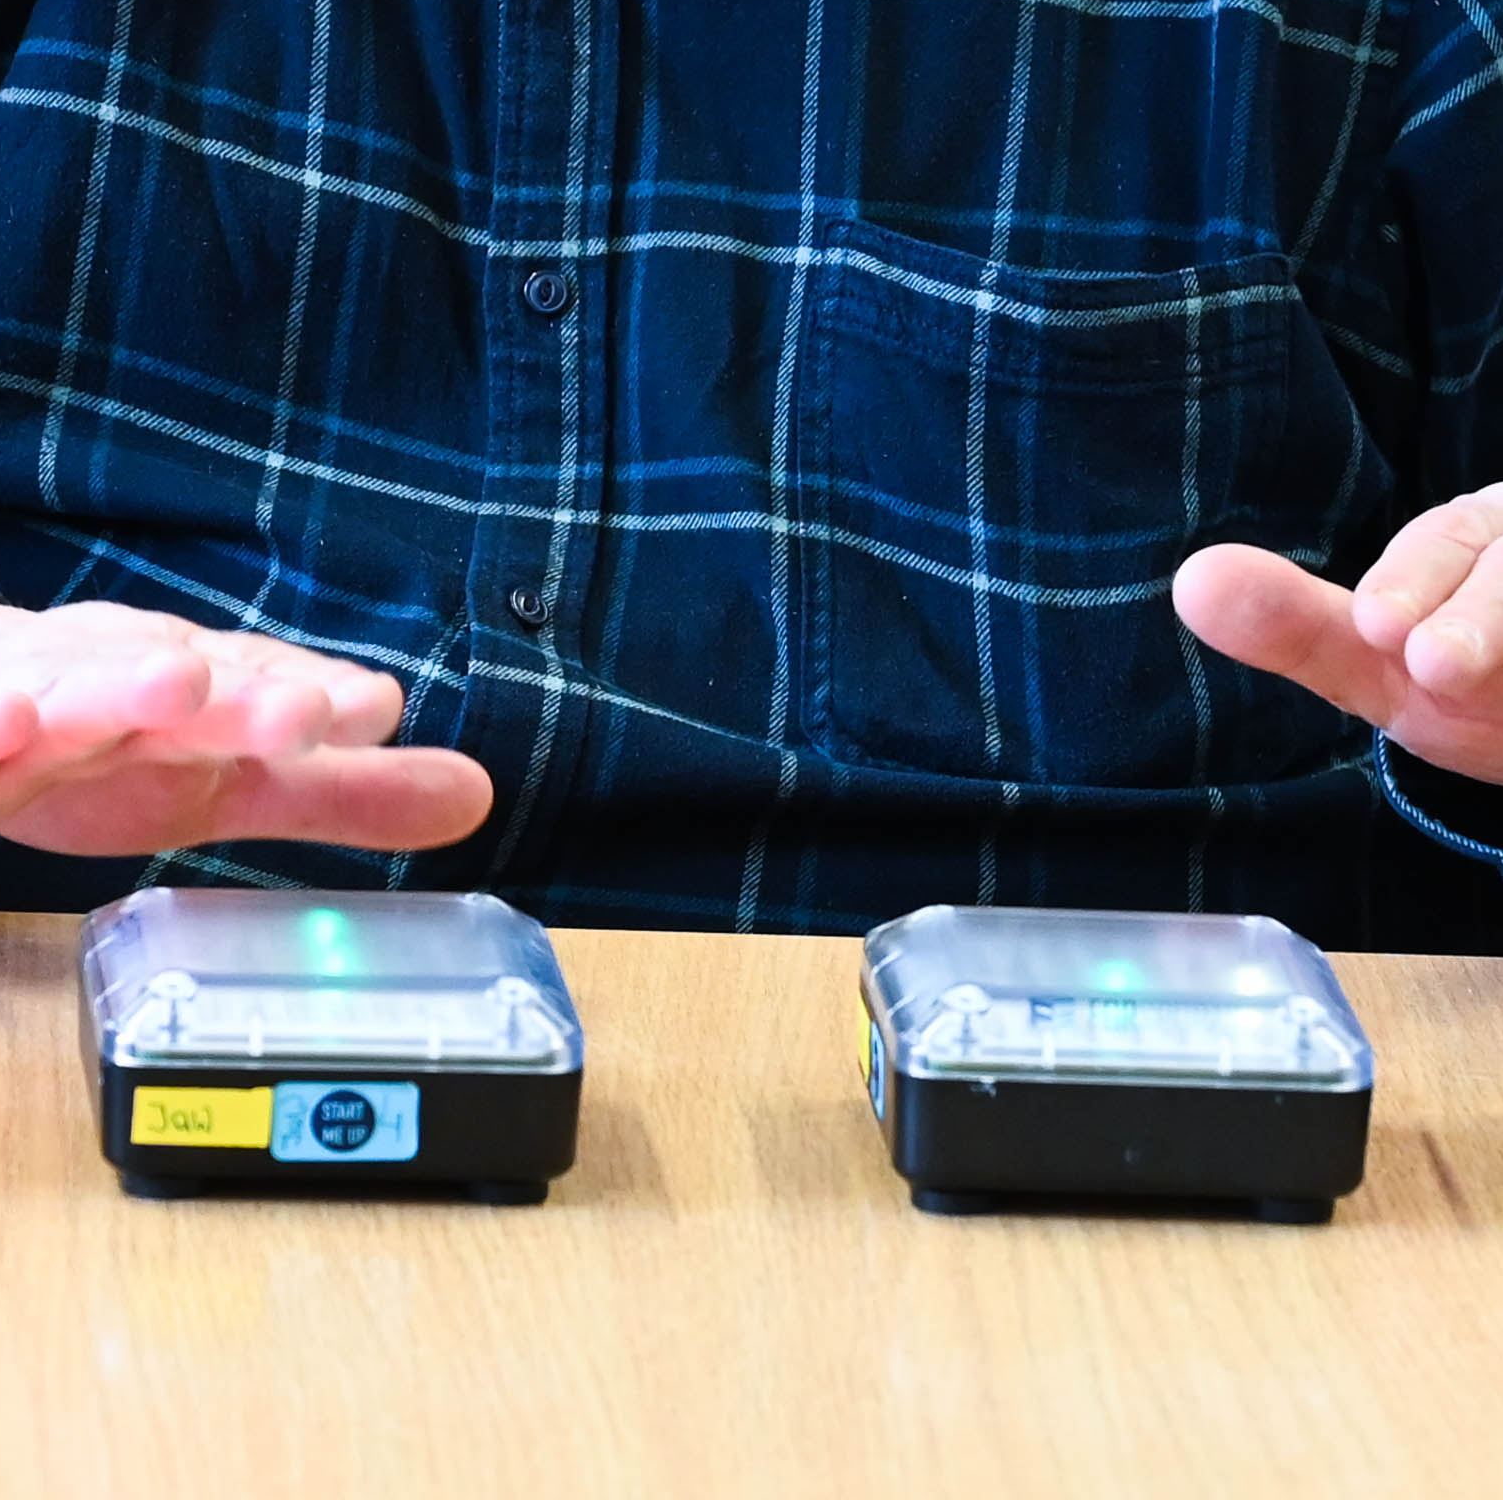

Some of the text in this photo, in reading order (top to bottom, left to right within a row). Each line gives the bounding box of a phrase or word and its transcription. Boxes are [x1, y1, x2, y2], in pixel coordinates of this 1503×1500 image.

[321, 1100, 365, 1121] START
[321, 1126, 367, 1145] ME UP
